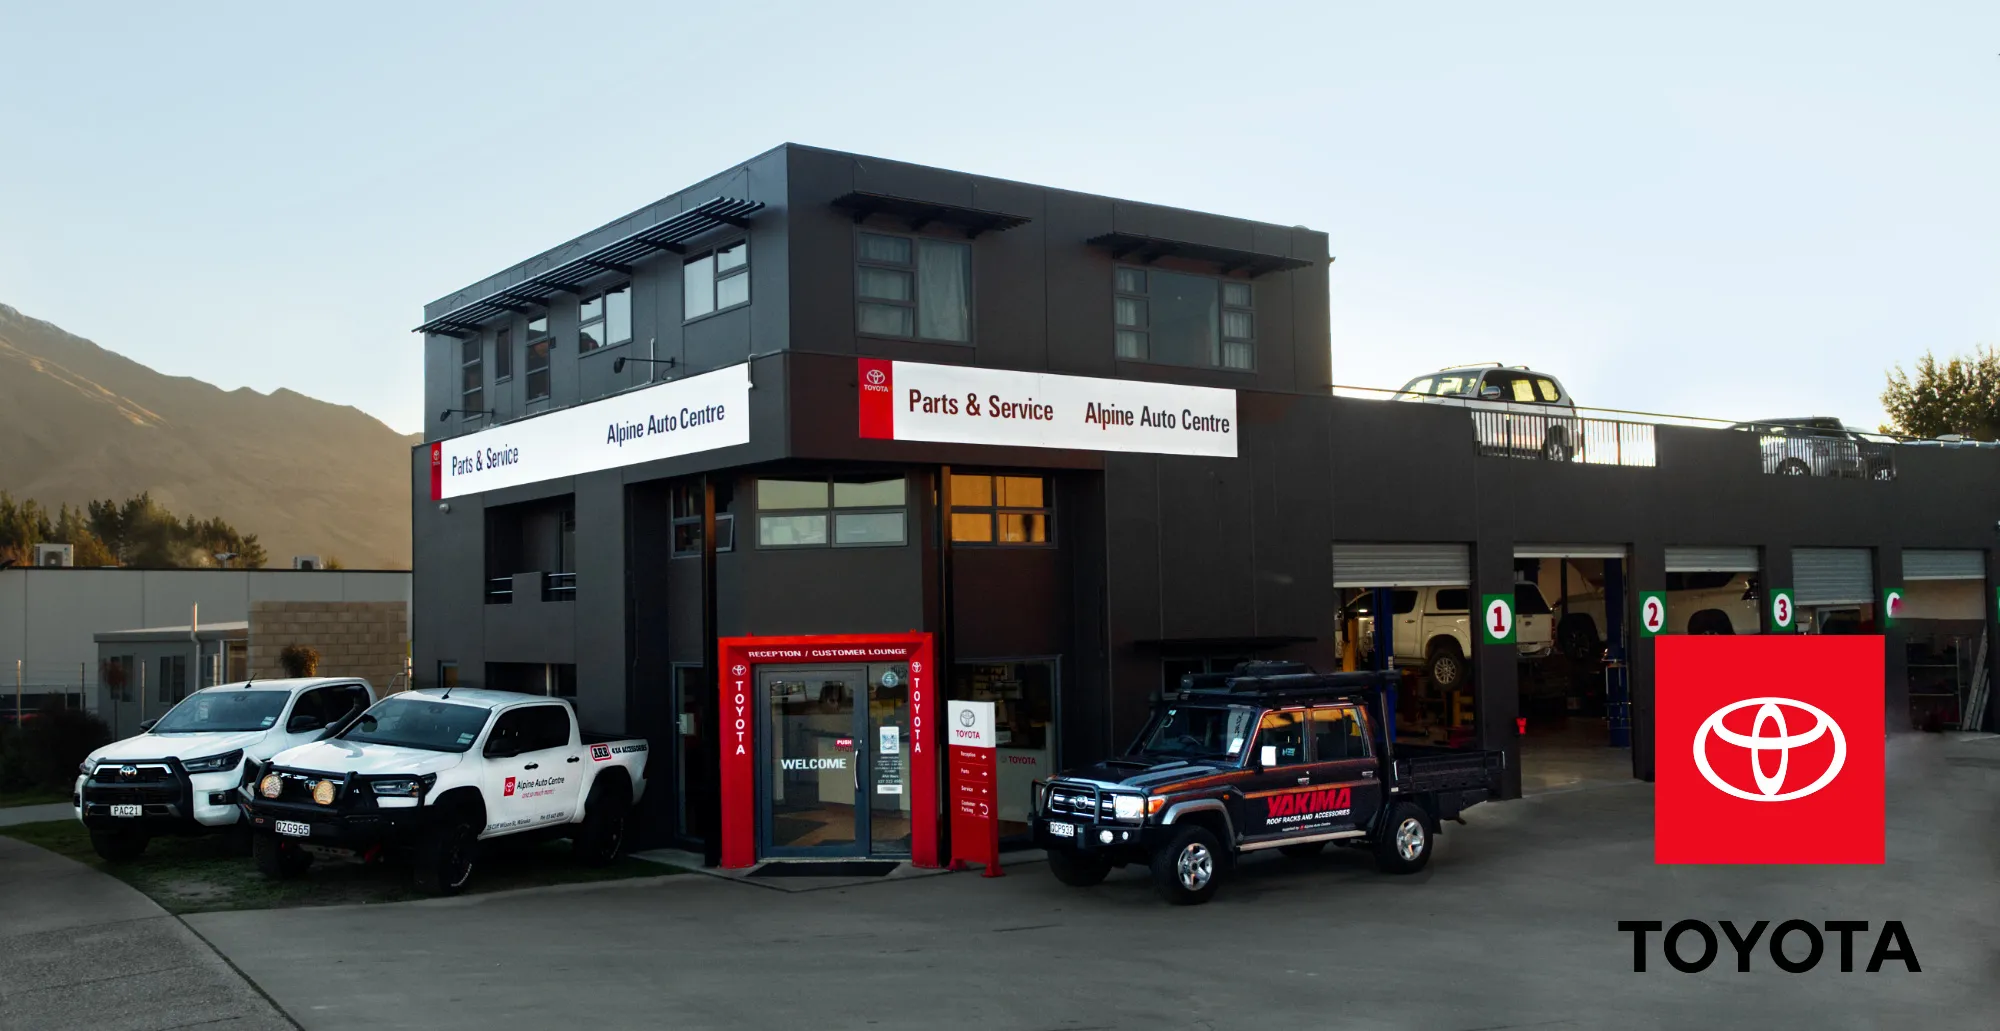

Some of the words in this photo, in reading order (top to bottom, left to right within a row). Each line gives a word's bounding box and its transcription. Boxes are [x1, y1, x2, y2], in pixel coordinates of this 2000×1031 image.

[863, 384, 889, 393] TOYOTA
[909, 388, 959, 415] Parts
[965, 392, 981, 417] &
[988, 395, 1054, 421] Service
[607, 420, 644, 447] Alpine
[647, 414, 677, 435] Auto
[680, 404, 725, 429] Centre
[1085, 402, 1134, 430] Alpine
[1140, 405, 1176, 429] Auto
[1182, 409, 1230, 433] Centre
[452, 455, 474, 476] Parts
[475, 449, 483, 471] &
[486, 443, 519, 469] Service
[1493, 606, 1505, 632] 1
[1647, 601, 1659, 626] 2
[1778, 598, 1788, 622] 3
[748, 650, 801, 658] RECEPTION
[734, 680, 746, 755] TOYOTA
[913, 677, 922, 753] TOYOTA
[955, 729, 981, 739] TOYOTA
[780, 757, 847, 770] WELCOME
[1008, 755, 1036, 765] TOYOTA
[516, 779, 535, 790] Alpine
[535, 778, 548, 787] Auto
[548, 776, 565, 784] Centre
[113, 806, 139, 815] PAC21
[1267, 787, 1351, 818] YAKIMA
[276, 821, 309, 835] QZG965
[1266, 817, 1282, 826] ROOF
[1282, 815, 1301, 824] RACKS
[1301, 813, 1313, 821] AND
[1314, 808, 1351, 819] ACCESSORIES
